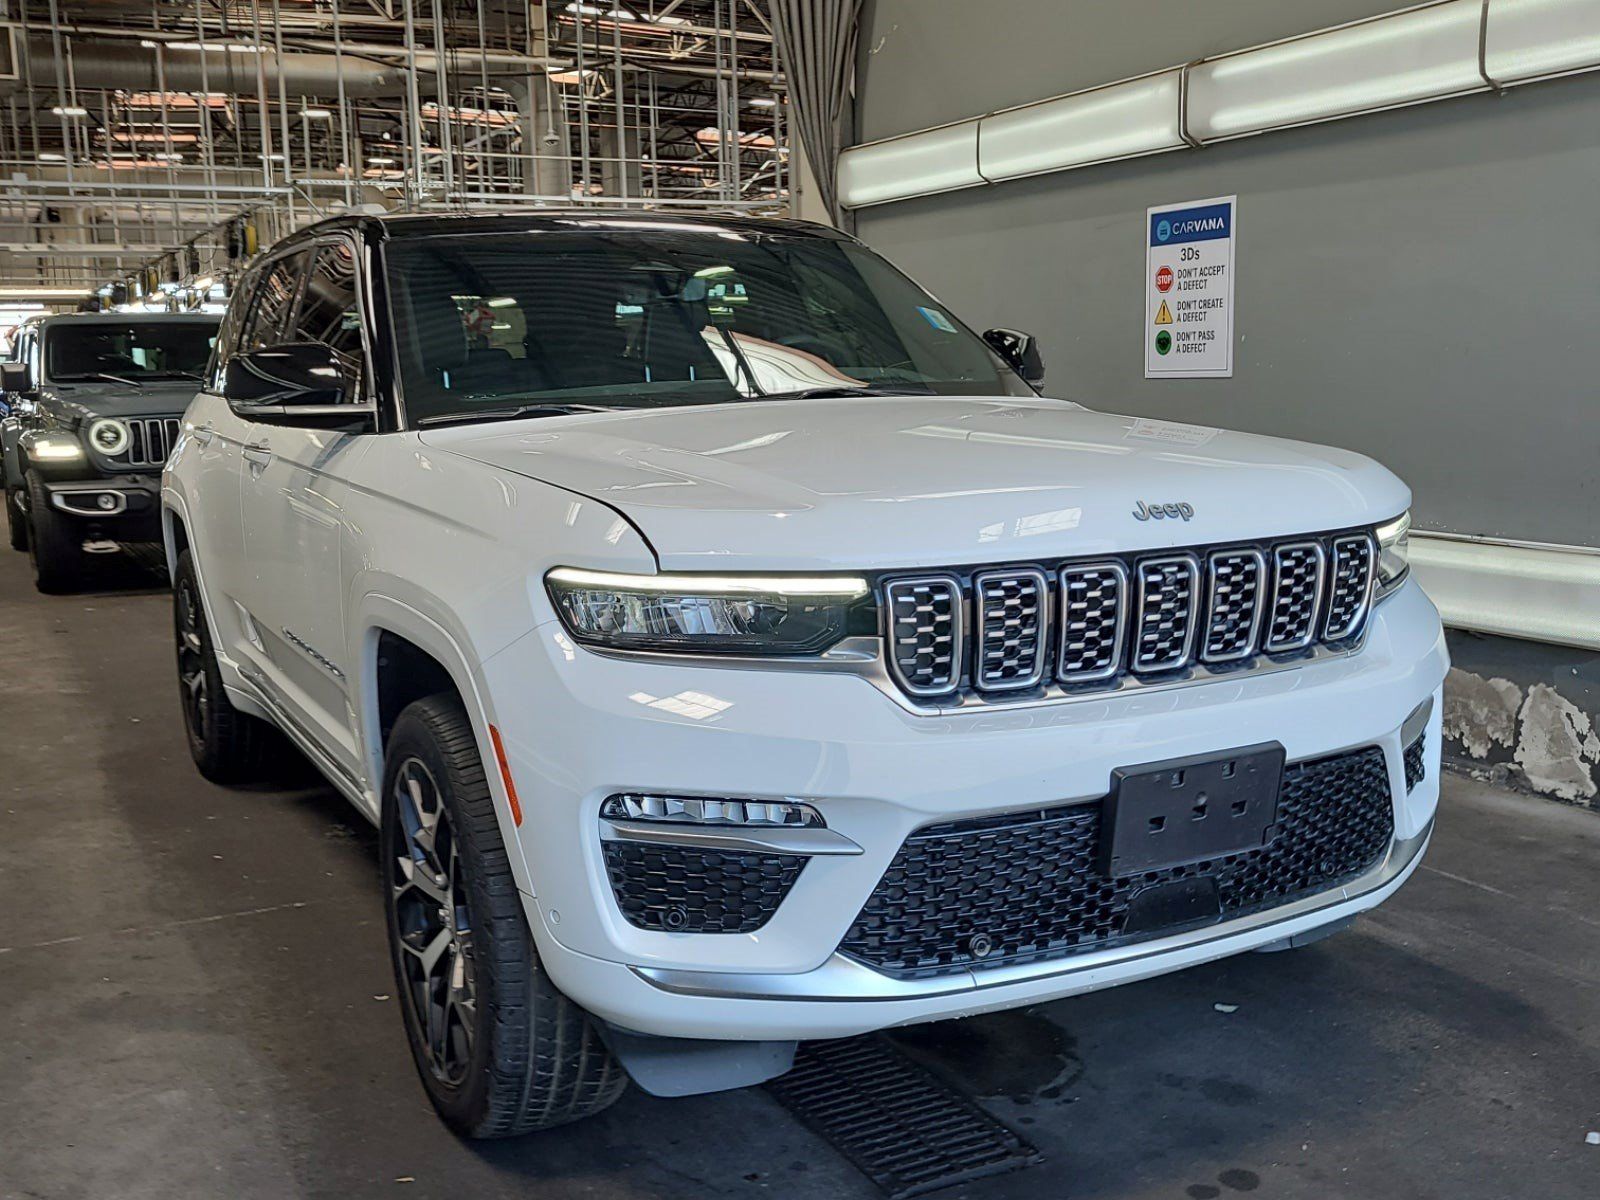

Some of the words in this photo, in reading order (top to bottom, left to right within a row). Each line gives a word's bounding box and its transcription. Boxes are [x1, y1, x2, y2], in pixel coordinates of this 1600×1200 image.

[1172, 216, 1224, 235] CARVANA
[1180, 247, 1200, 261] 3Ds
[1177, 267, 1198, 279] DON'T
[1199, 265, 1225, 277] ACCEPT
[1157, 274, 1172, 286] STOP
[1177, 281, 1182, 291] A
[1183, 279, 1208, 291] DEFECT
[1177, 300, 1197, 311] DON'T
[1198, 298, 1223, 310] CREATE
[1177, 313, 1182, 322] A
[1182, 311, 1207, 322] DEFECT
[1176, 331, 1196, 342] DON'T
[1198, 330, 1215, 341] PASS
[1176, 344, 1181, 353] A
[1182, 342, 1206, 354] DEFECT
[1132, 500, 1195, 522] Jeep
